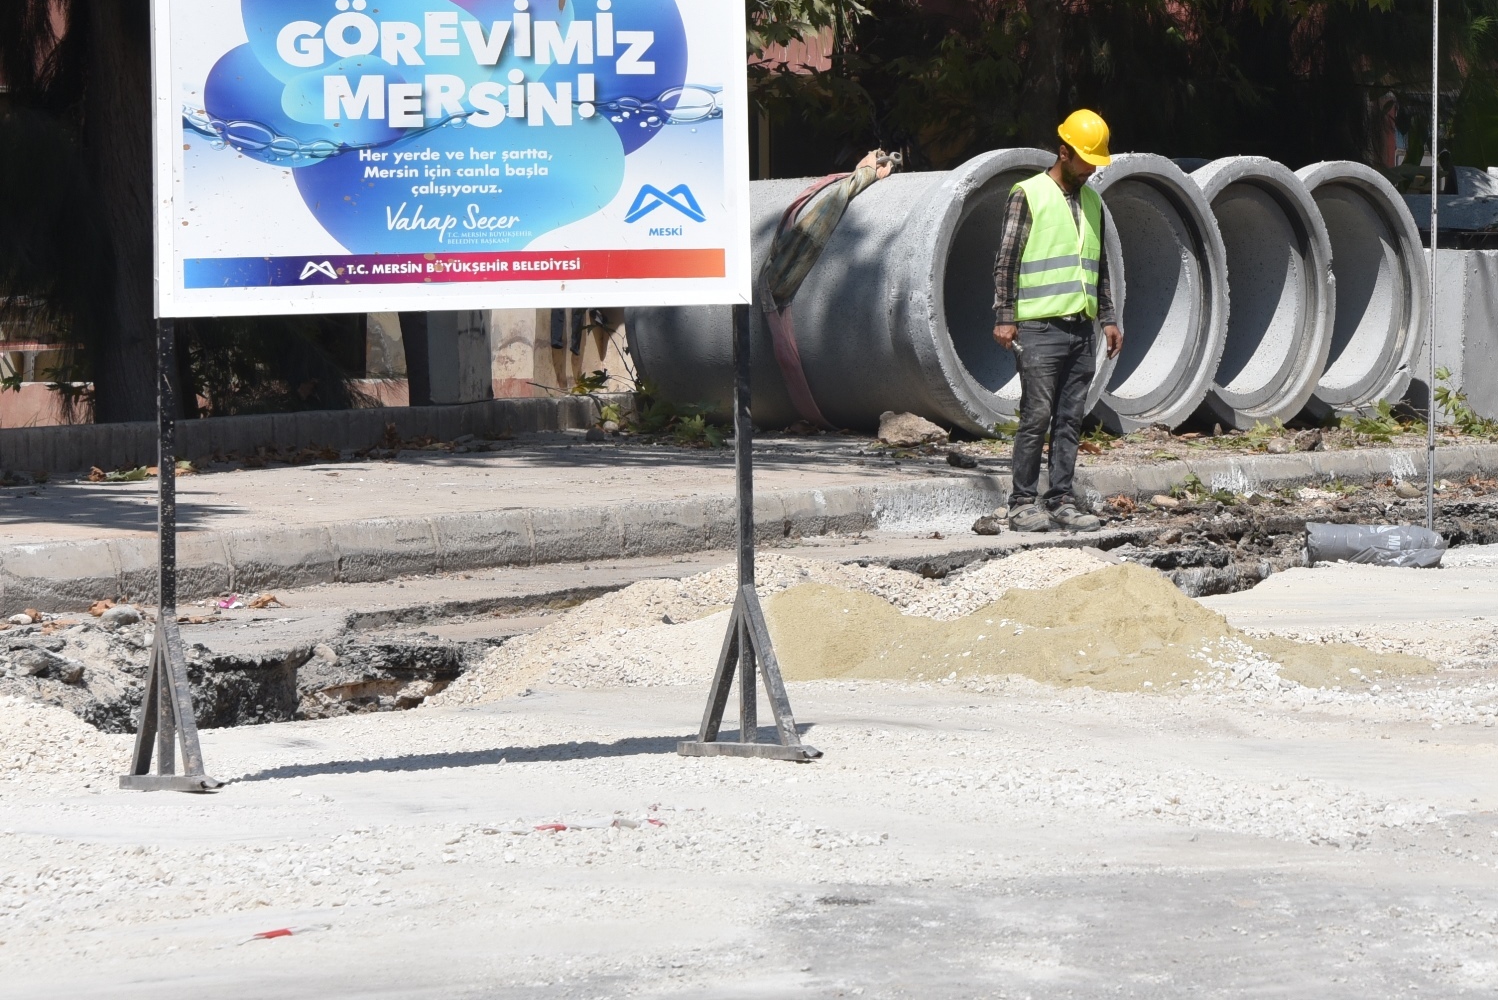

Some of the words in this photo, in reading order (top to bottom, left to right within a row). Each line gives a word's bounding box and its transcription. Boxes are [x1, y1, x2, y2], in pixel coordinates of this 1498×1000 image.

[323, 68, 596, 129] MERSİN!
[359, 149, 389, 162] Her
[393, 147, 440, 165] yerde
[445, 150, 465, 161] ve
[469, 147, 497, 160] her
[501, 148, 553, 163] şartta,
[364, 166, 419, 179] Mersin
[424, 164, 451, 180] için
[456, 164, 500, 178] canla
[505, 163, 549, 179] başla
[411, 181, 502, 197] çalışıyoruz.
[386, 202, 457, 243] Vahap
[462, 204, 520, 231] Seçer
[648, 225, 683, 237] MESKİ
[346, 264, 369, 275] T.C.
[372, 261, 422, 274] MERSİN
[512, 257, 581, 271] BELEDİYESİ
